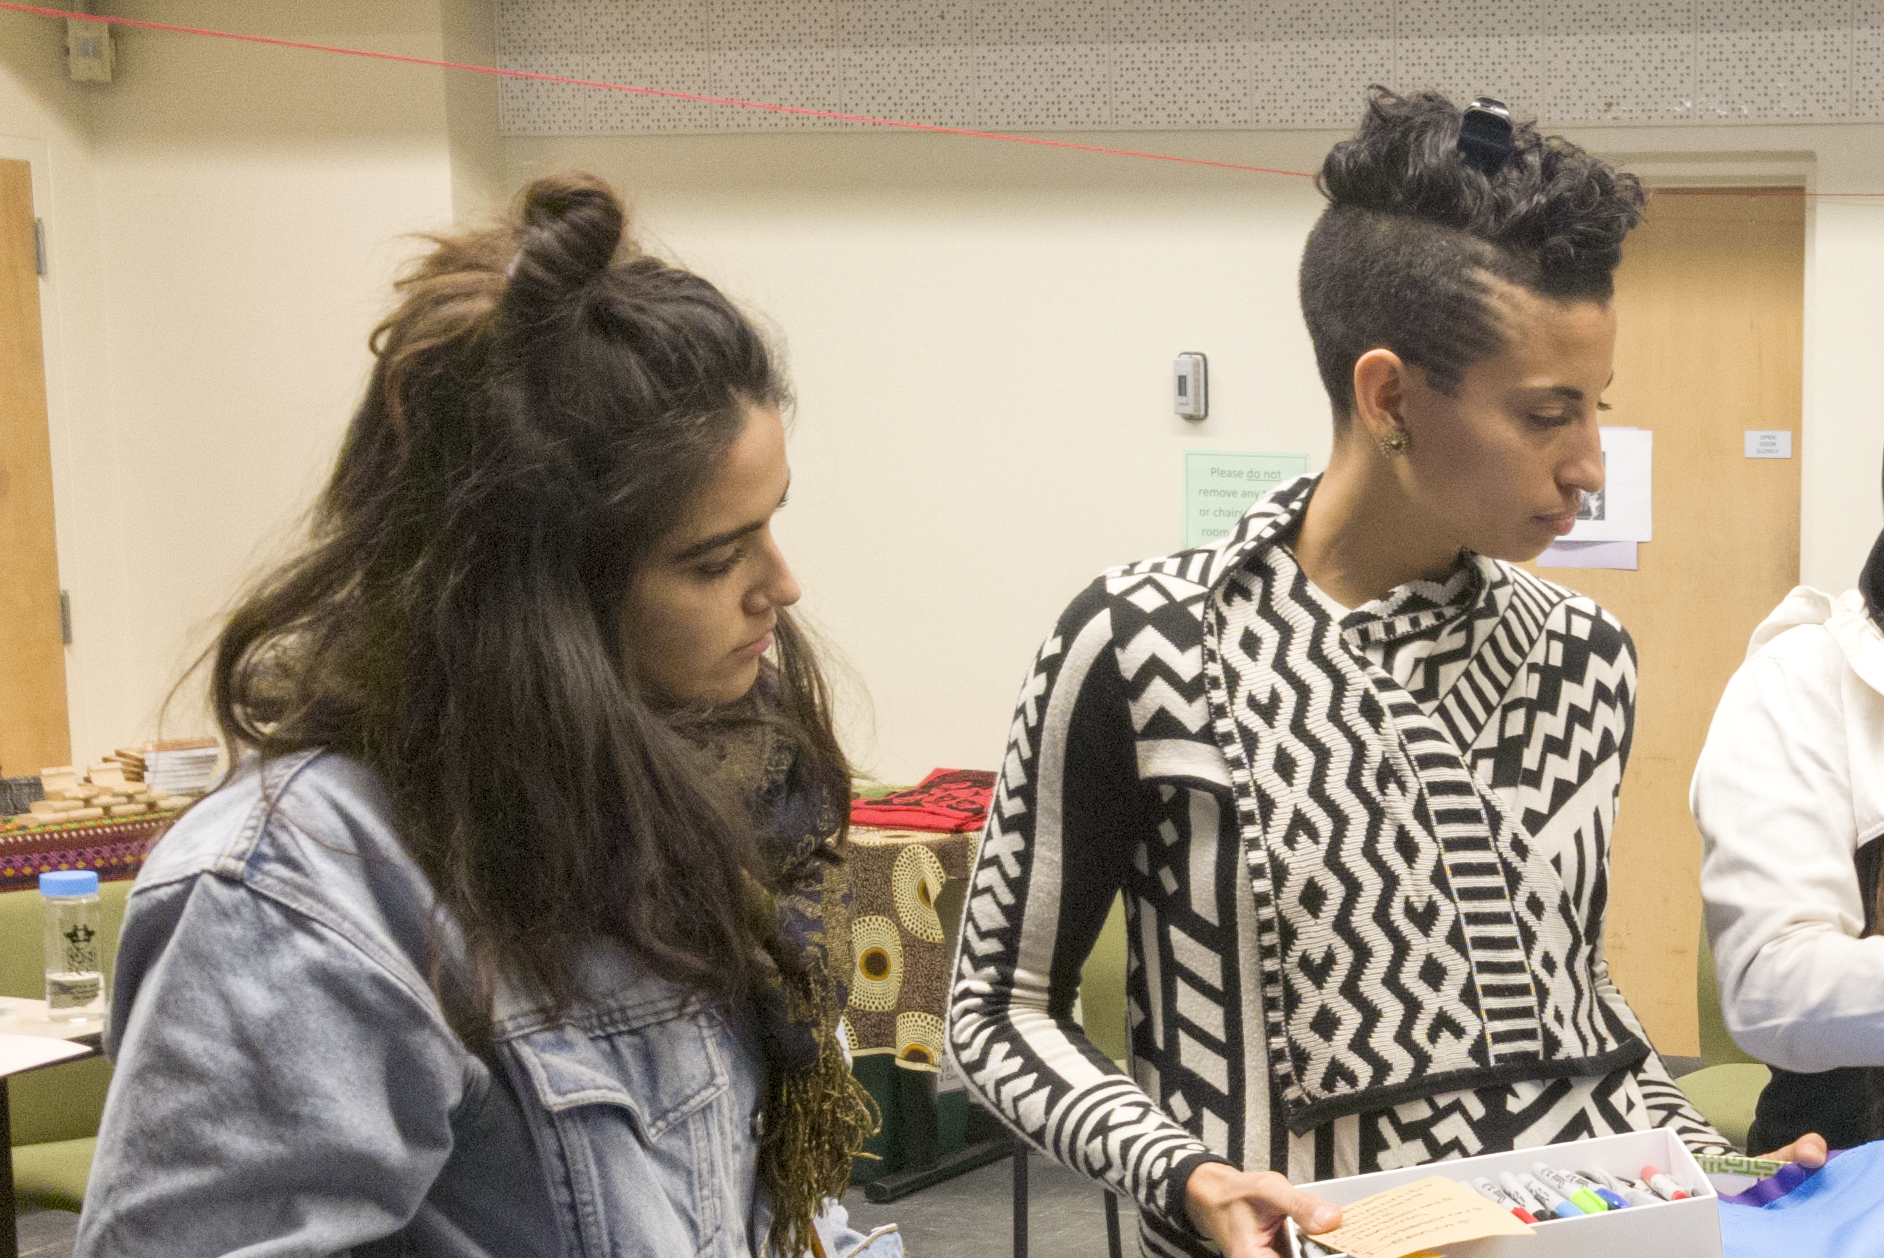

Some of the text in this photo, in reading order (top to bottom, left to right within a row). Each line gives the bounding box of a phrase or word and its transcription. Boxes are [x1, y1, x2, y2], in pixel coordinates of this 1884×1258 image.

[1210, 467, 1282, 480] Please do not
[1198, 488, 1238, 498] remove
[1241, 490, 1260, 499] any
[1199, 508, 1210, 517] or
